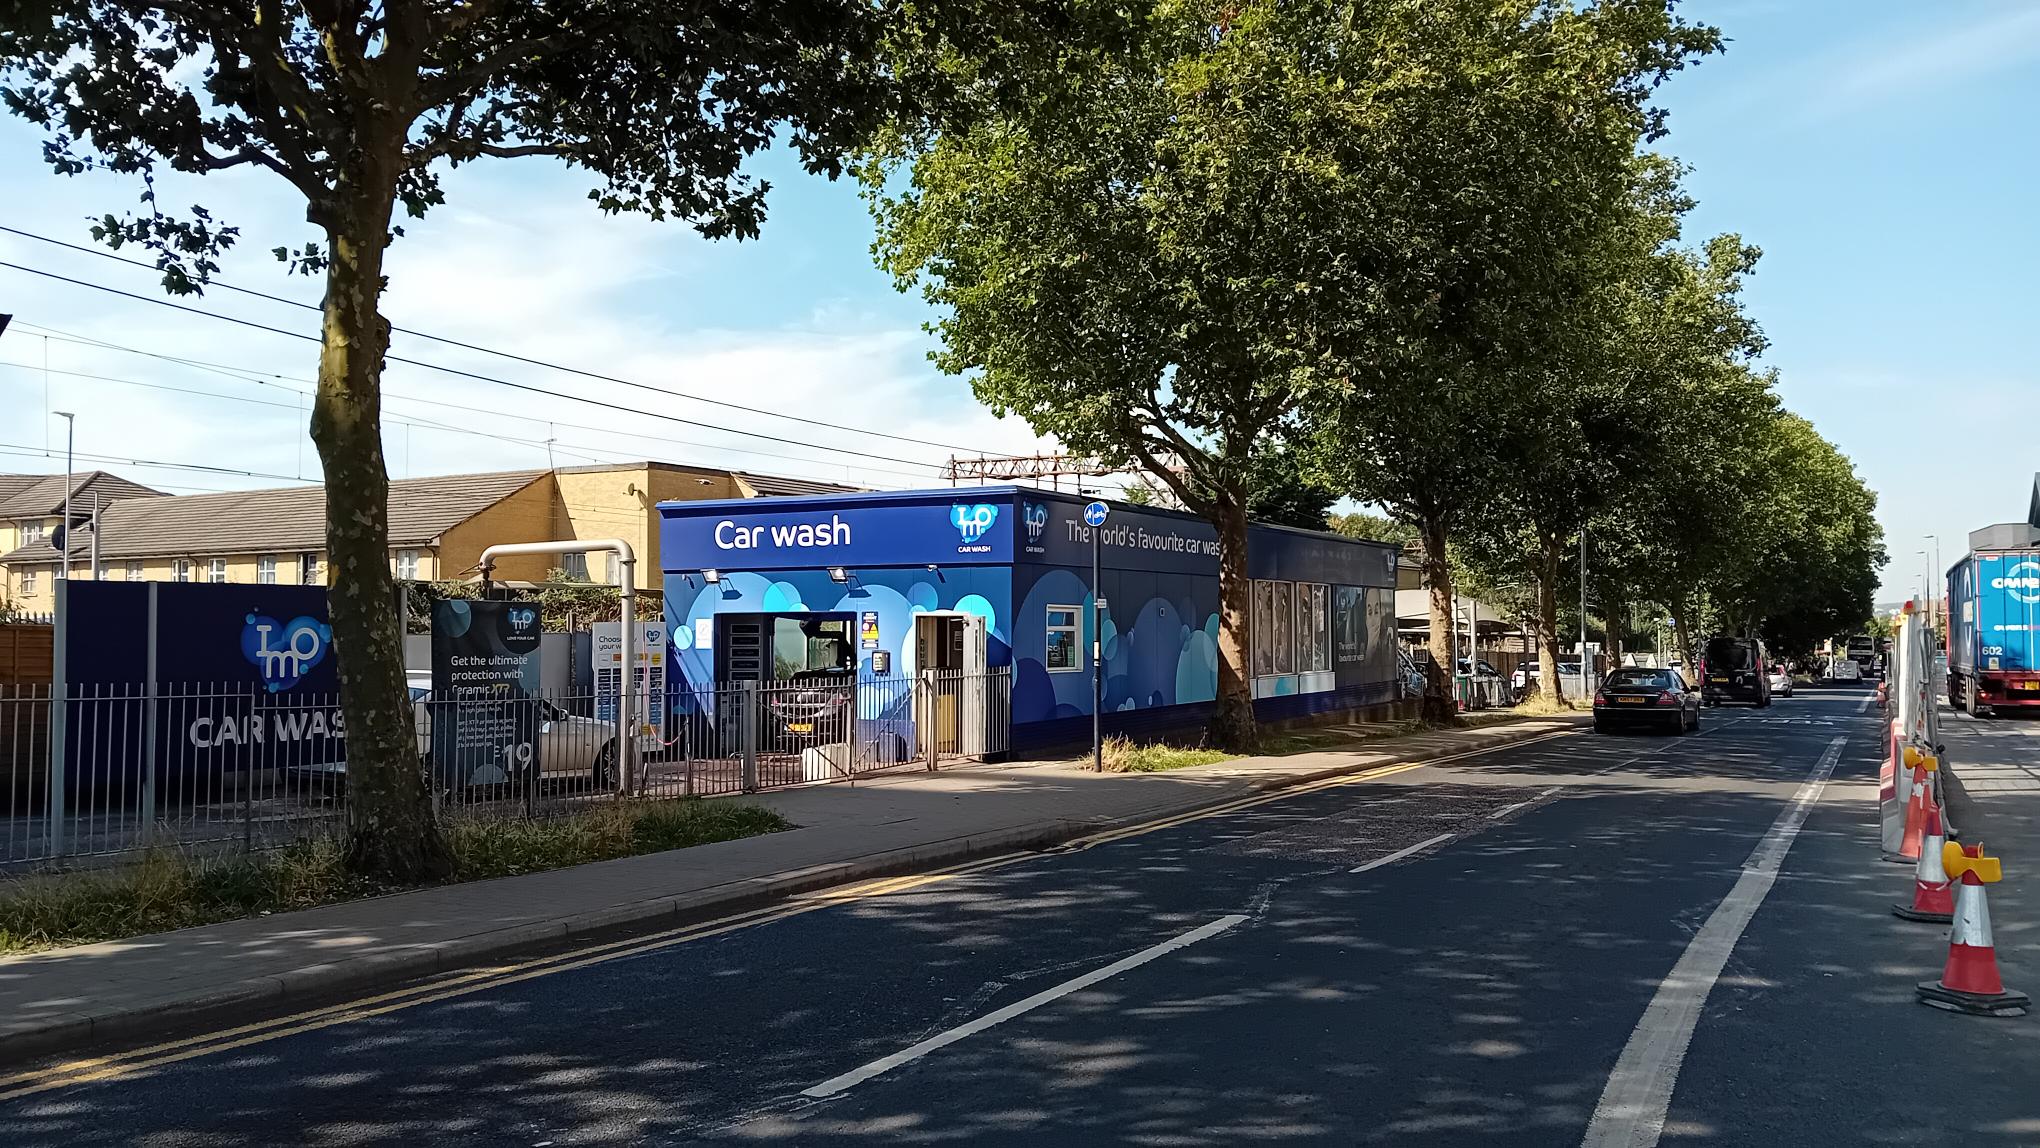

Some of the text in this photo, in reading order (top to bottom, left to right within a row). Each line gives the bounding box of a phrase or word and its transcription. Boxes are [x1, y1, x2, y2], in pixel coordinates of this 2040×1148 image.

[714, 514, 851, 550] Car wash
[1066, 520, 1089, 542] The
[1138, 528, 1183, 552] favourite
[1186, 539, 1201, 553] car
[451, 655, 528, 666] Get the ultimate
[1982, 646, 2003, 656] 602
[451, 668, 524, 682] protection with
[190, 715, 265, 748] CAR
